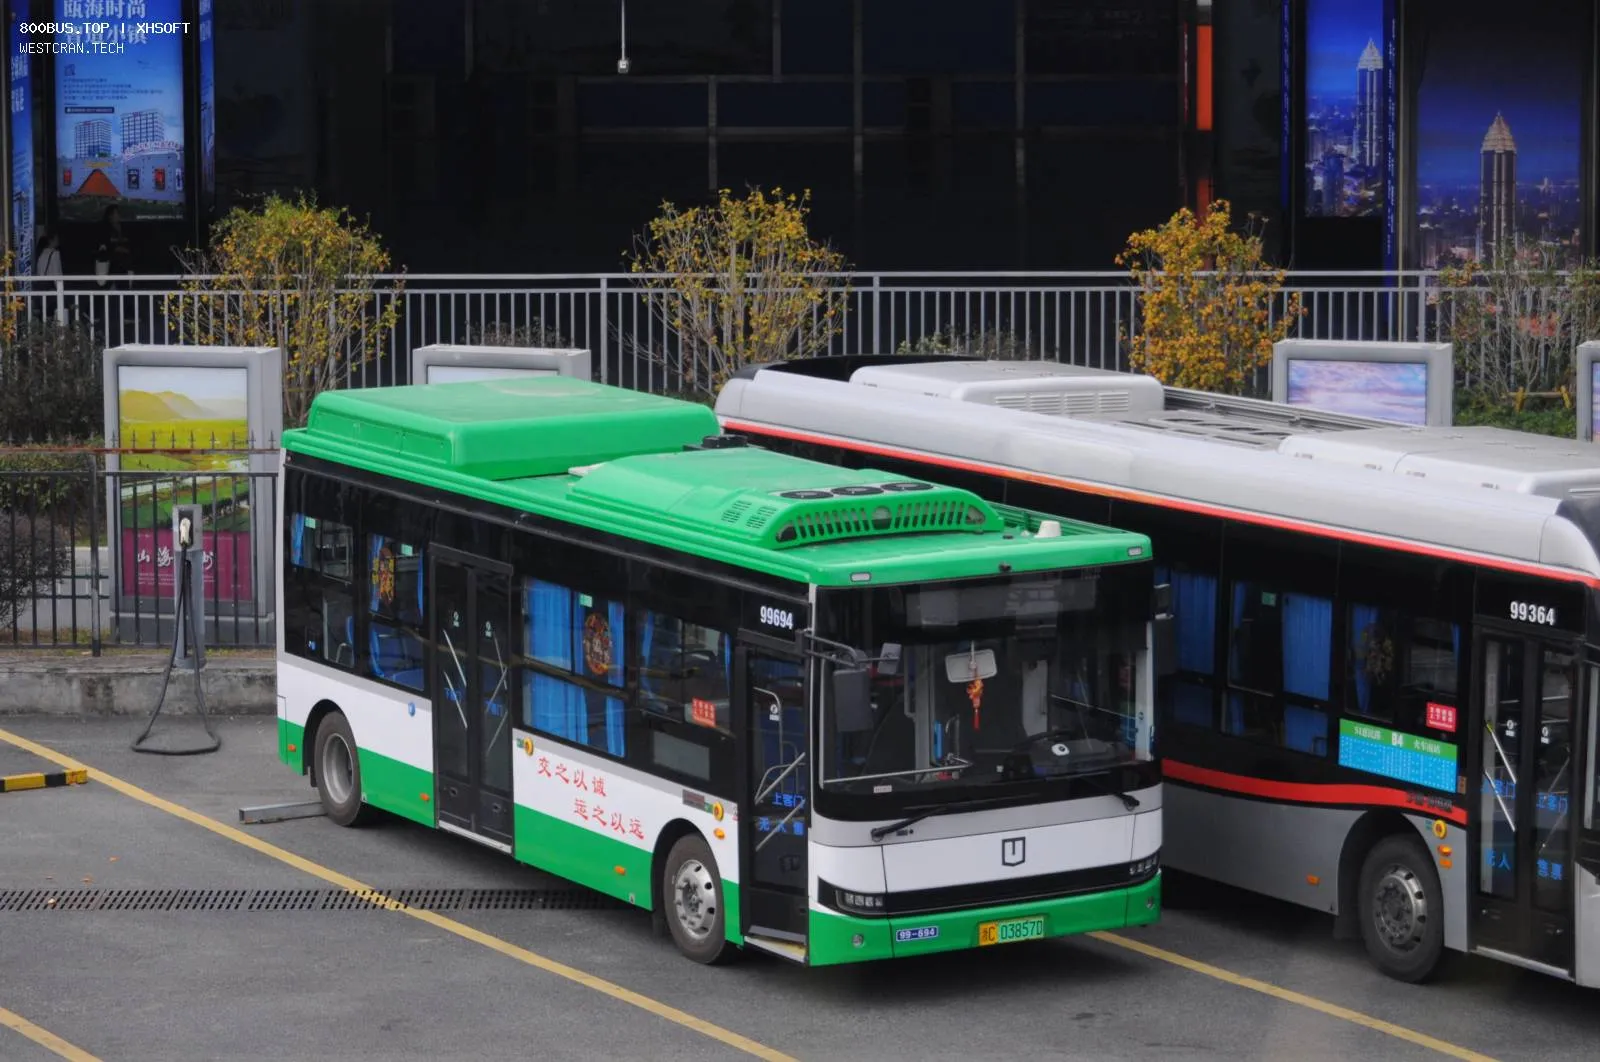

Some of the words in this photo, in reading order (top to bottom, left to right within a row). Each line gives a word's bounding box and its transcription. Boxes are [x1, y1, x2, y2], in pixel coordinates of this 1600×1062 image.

[760, 605, 794, 630] 99694
[1510, 601, 1556, 626] 99364
[537, 756, 607, 797] 交之以诚
[573, 799, 645, 840] 运之以远
[899, 928, 935, 940] 99-694
